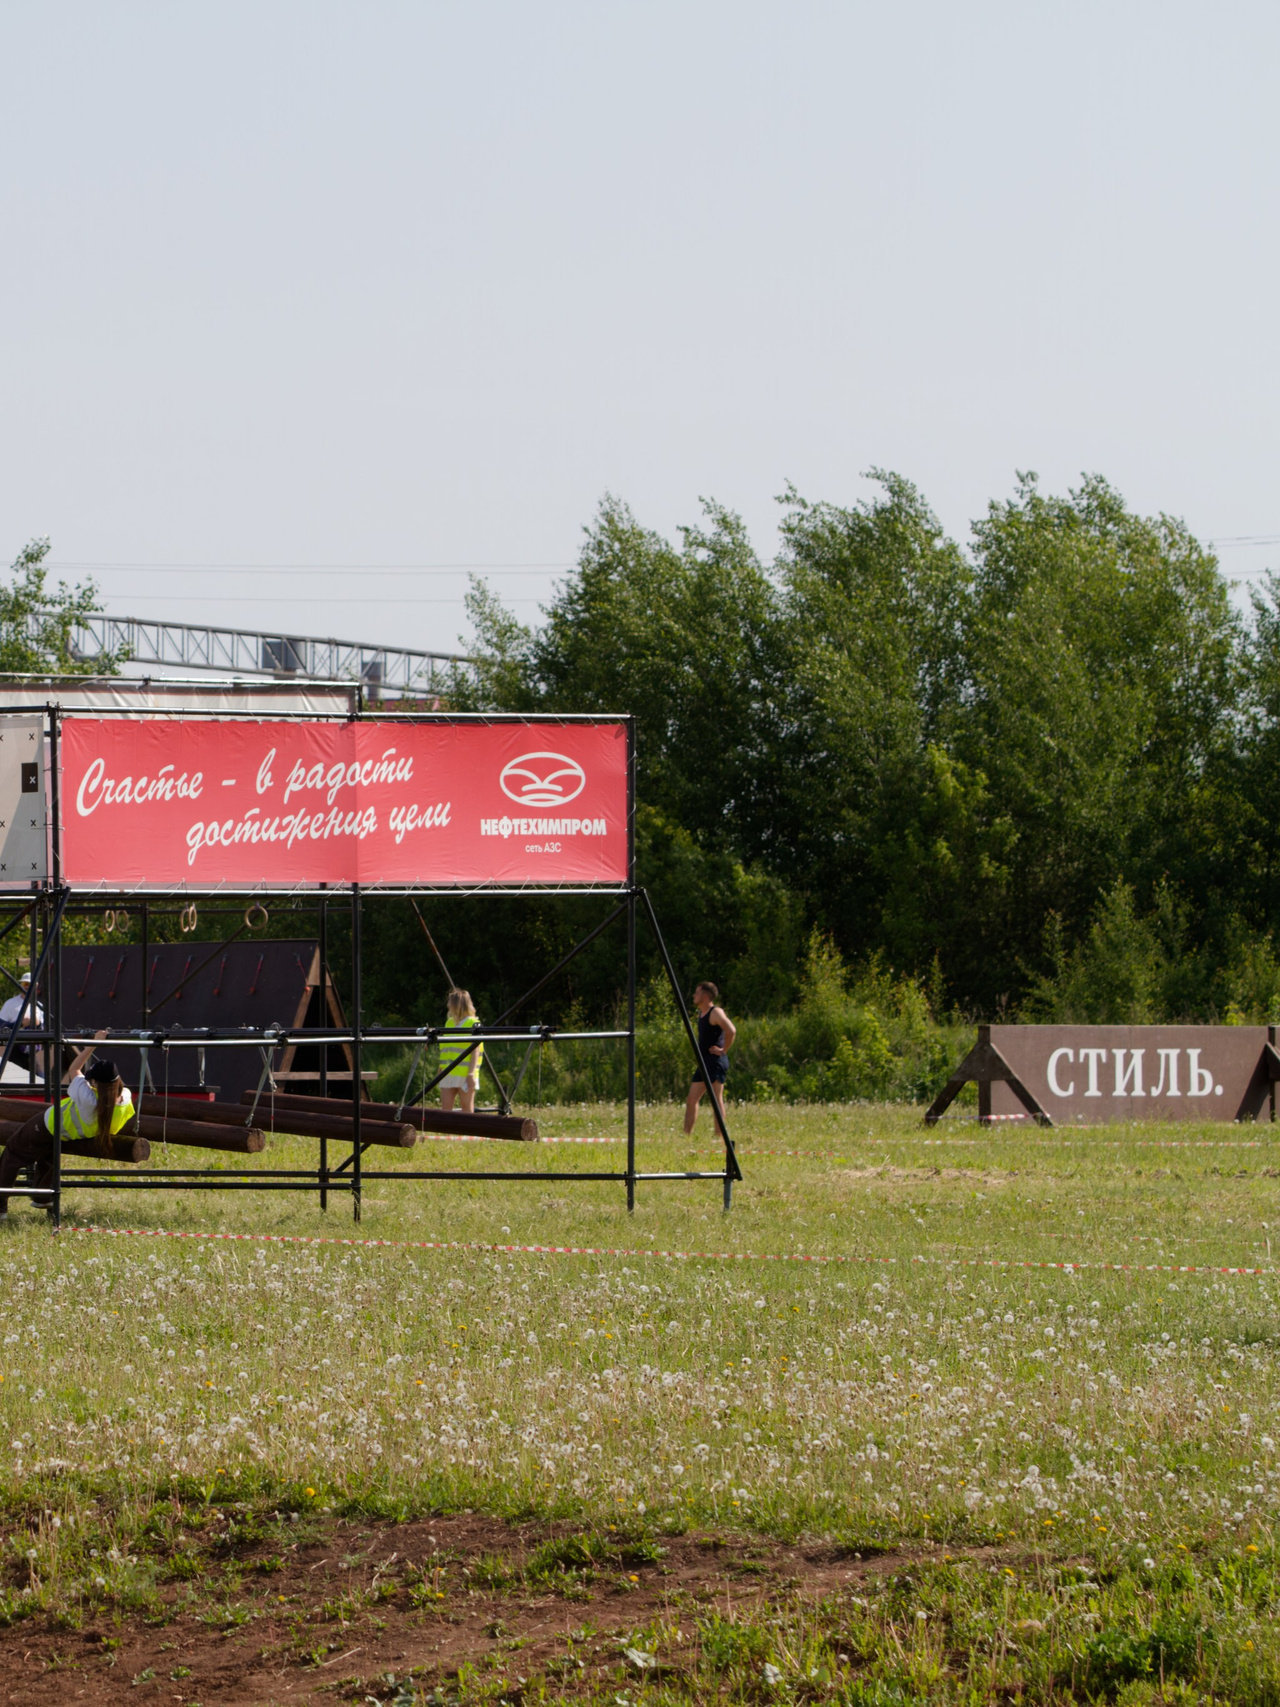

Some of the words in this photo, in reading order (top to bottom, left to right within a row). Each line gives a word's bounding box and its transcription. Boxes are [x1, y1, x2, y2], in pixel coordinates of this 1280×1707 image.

[76, 758, 203, 817] Счастье
[255, 747, 277, 796] в
[283, 747, 414, 805] радости
[185, 807, 378, 867] достижения
[389, 801, 451, 845] цели
[480, 815, 607, 839] НЕФТЕХИМПРОМ
[525, 843, 543, 853] сеть
[543, 842, 562, 853] АЗС
[1047, 1047, 1224, 1097] СТИЛЬ.
